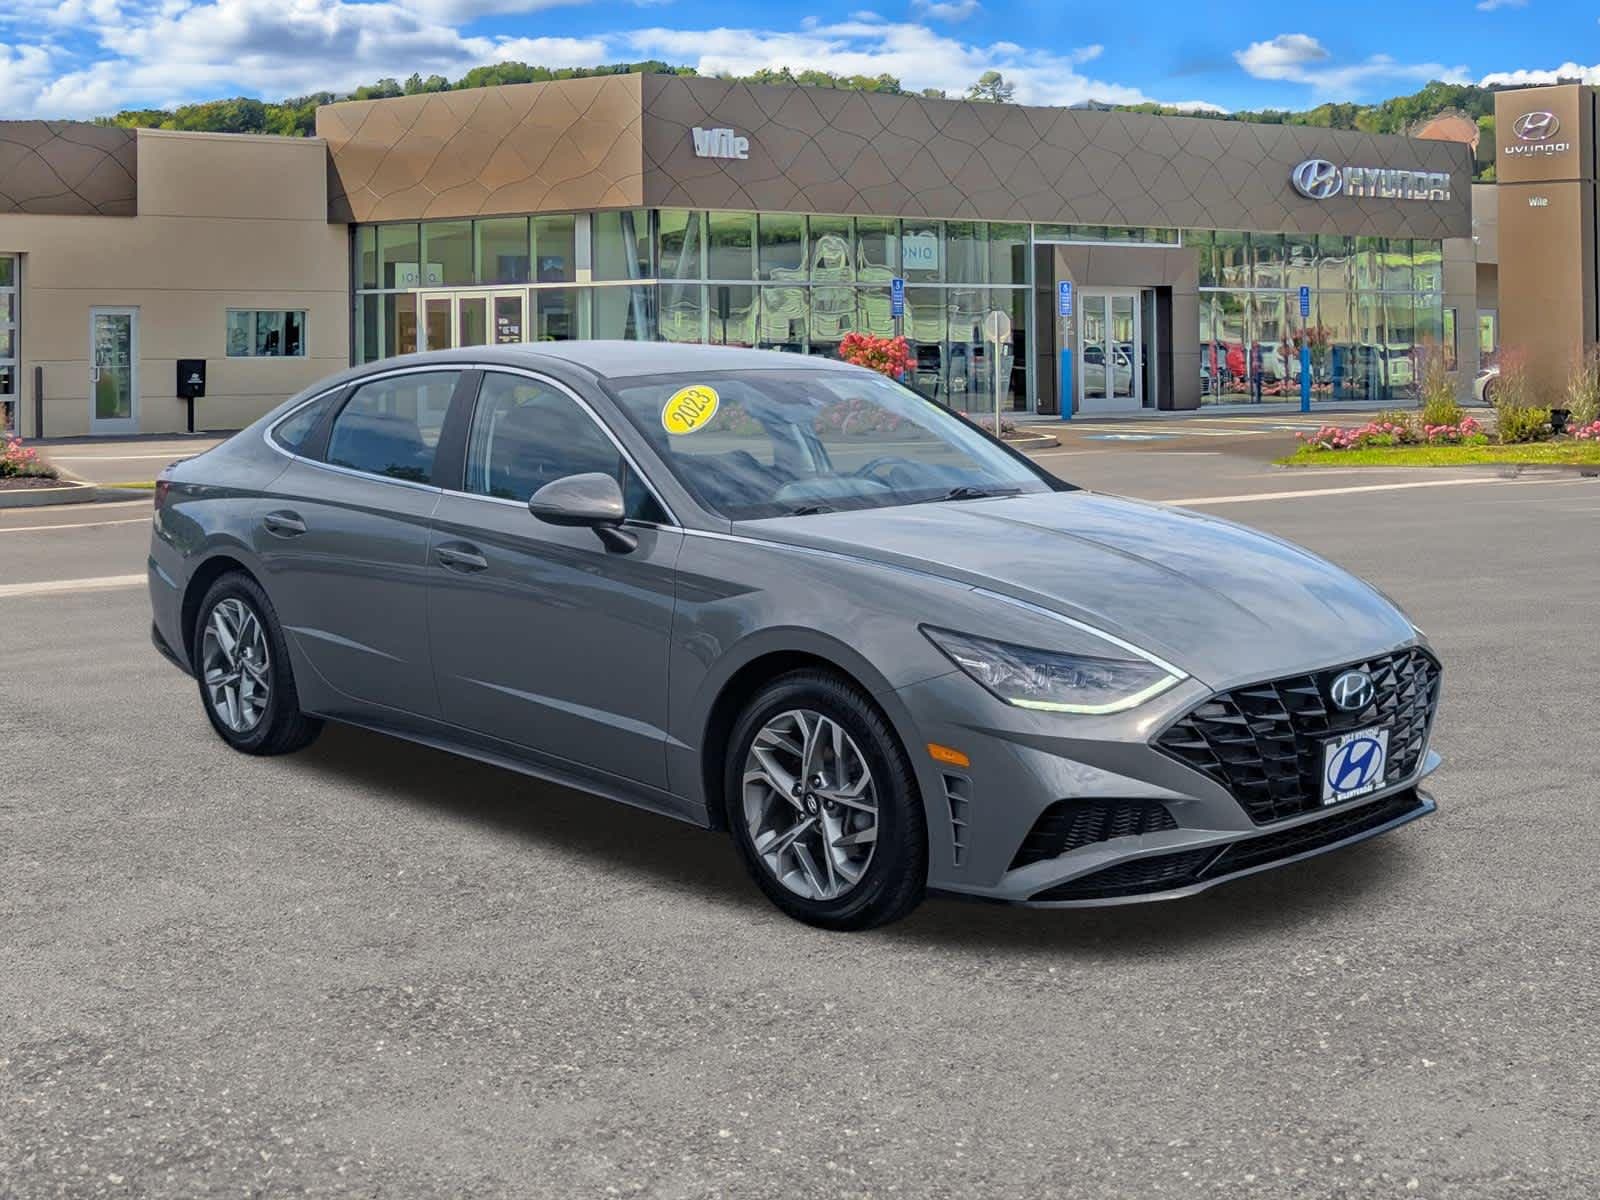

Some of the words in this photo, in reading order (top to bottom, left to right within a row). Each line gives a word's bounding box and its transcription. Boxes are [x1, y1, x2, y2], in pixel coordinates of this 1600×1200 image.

[692, 127, 749, 159] Wile
[1342, 167, 1450, 200] HYUNDAI
[1528, 197, 1548, 207] Wile
[671, 389, 711, 428] 2023
